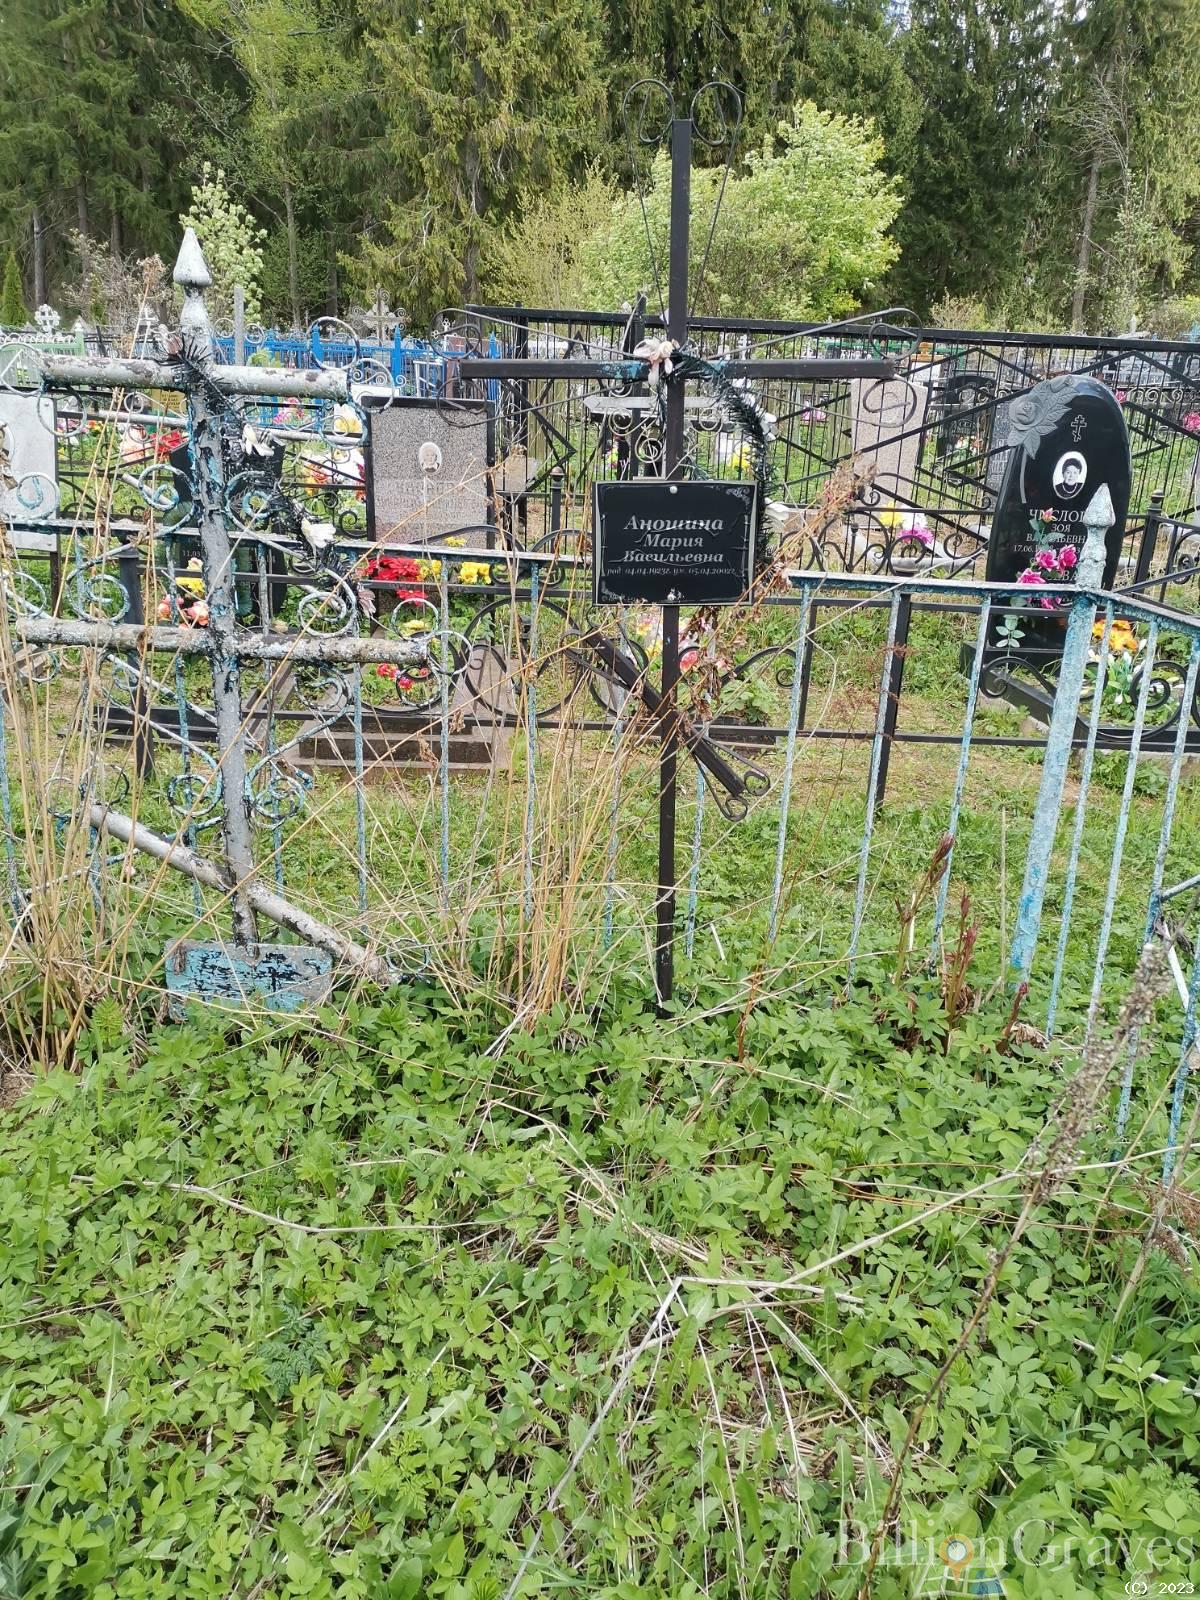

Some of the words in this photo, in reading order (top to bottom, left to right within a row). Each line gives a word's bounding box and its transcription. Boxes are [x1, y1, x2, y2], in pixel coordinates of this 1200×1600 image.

[623, 515, 724, 532] Аношина
[1051, 524, 1071, 532] ЗОЯ
[643, 533, 704, 551] Мария
[623, 550, 724, 563] Васильевна
